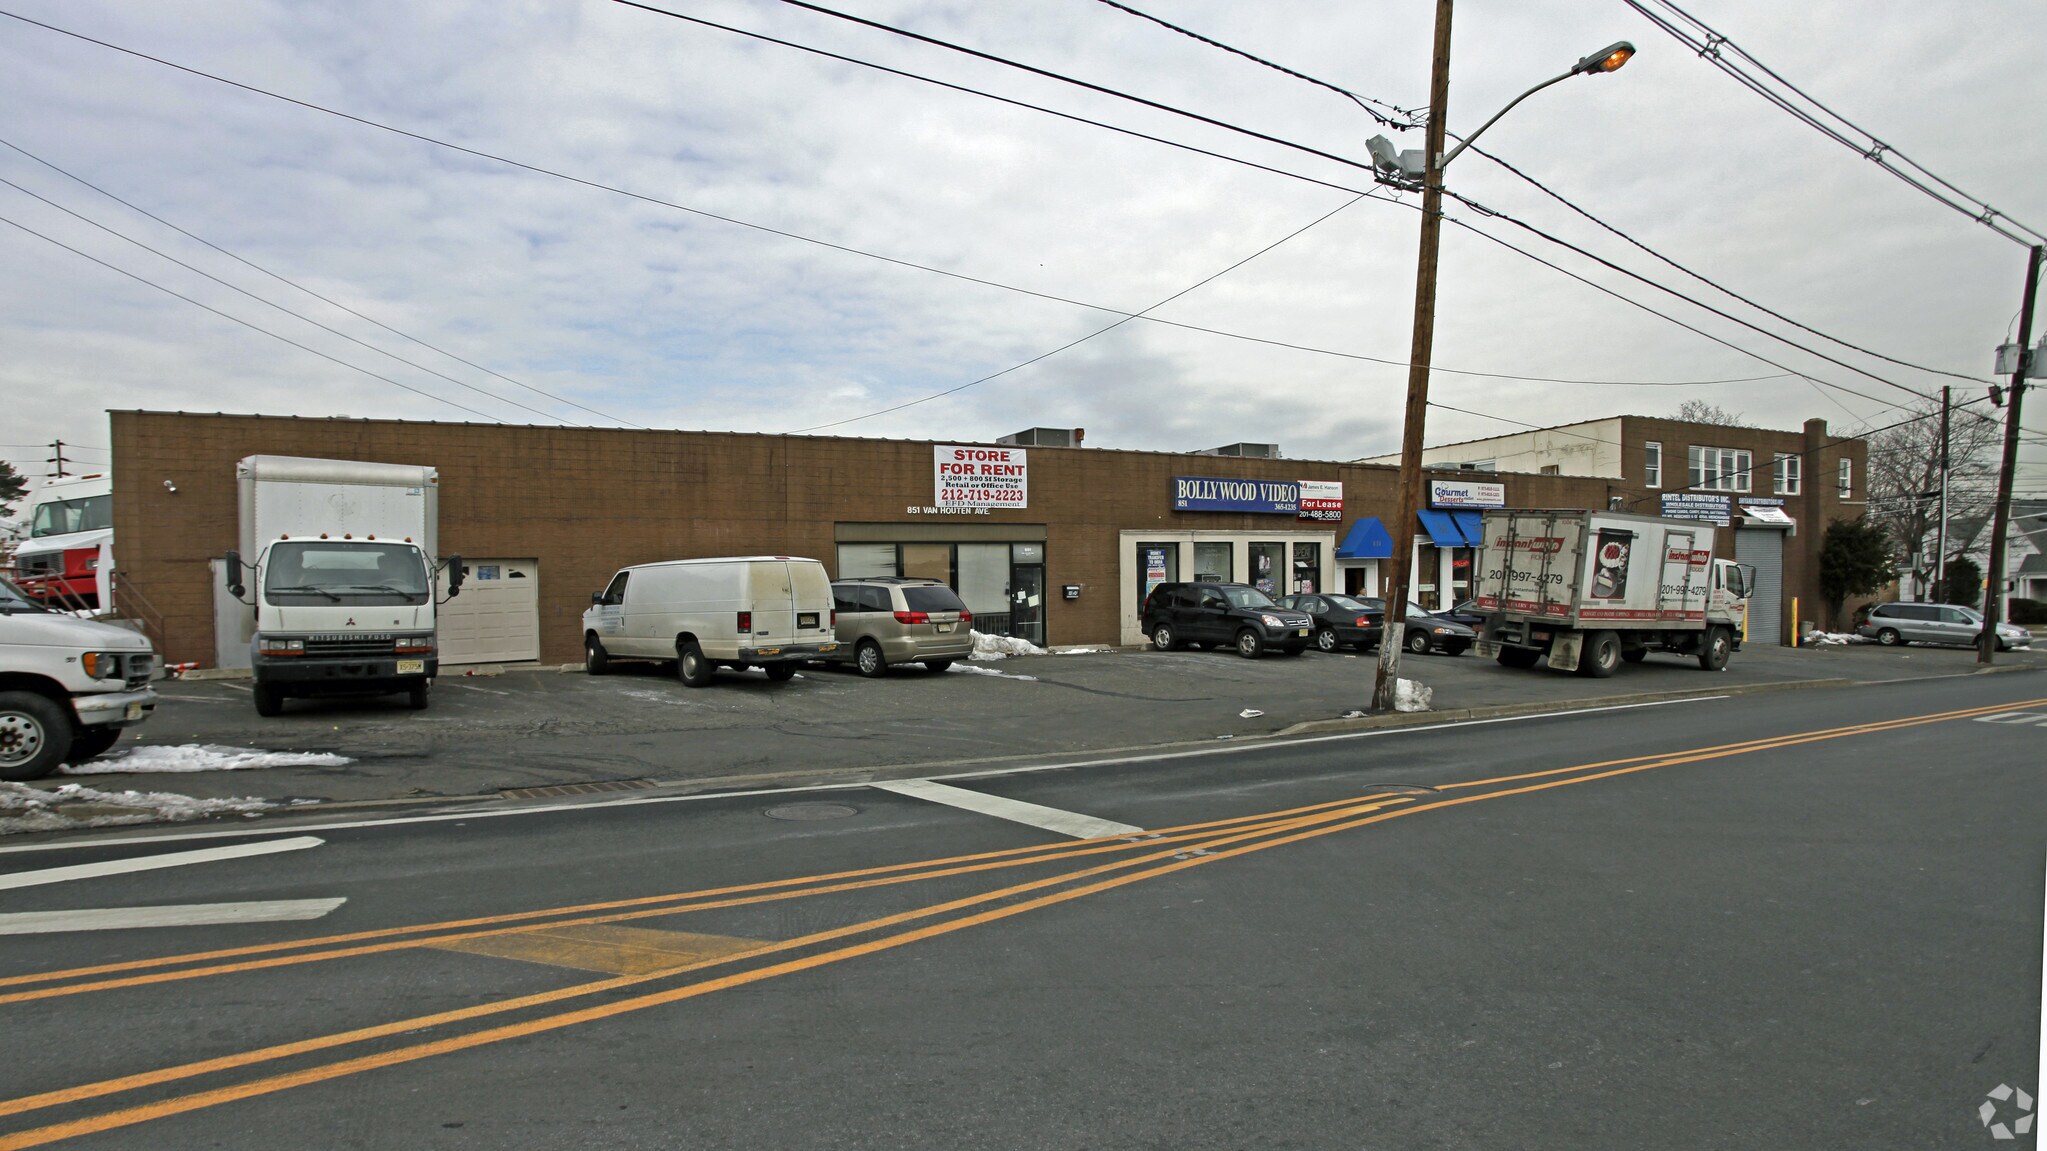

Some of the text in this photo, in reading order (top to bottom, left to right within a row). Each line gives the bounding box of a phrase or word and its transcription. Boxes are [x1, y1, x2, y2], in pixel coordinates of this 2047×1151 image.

[954, 449, 1011, 462] STORE
[940, 463, 1025, 476] FOR RENT
[993, 476, 1023, 484] Storage
[941, 489, 1024, 501] 212-719-2223
[1177, 480, 1297, 503] BOLLYWOOD VIDEO
[1435, 487, 1469, 498] Gourmet
[1317, 500, 1342, 508] Lease
[1439, 495, 1464, 503] Desserts
[907, 506, 920, 514] 851
[923, 506, 938, 514] VAN
[940, 507, 971, 515] HOUTEN
[1299, 510, 1341, 518] 201-488-5800
[1489, 569, 1563, 584] 201-997-4279
[1661, 584, 1707, 596] 201-997-4279
